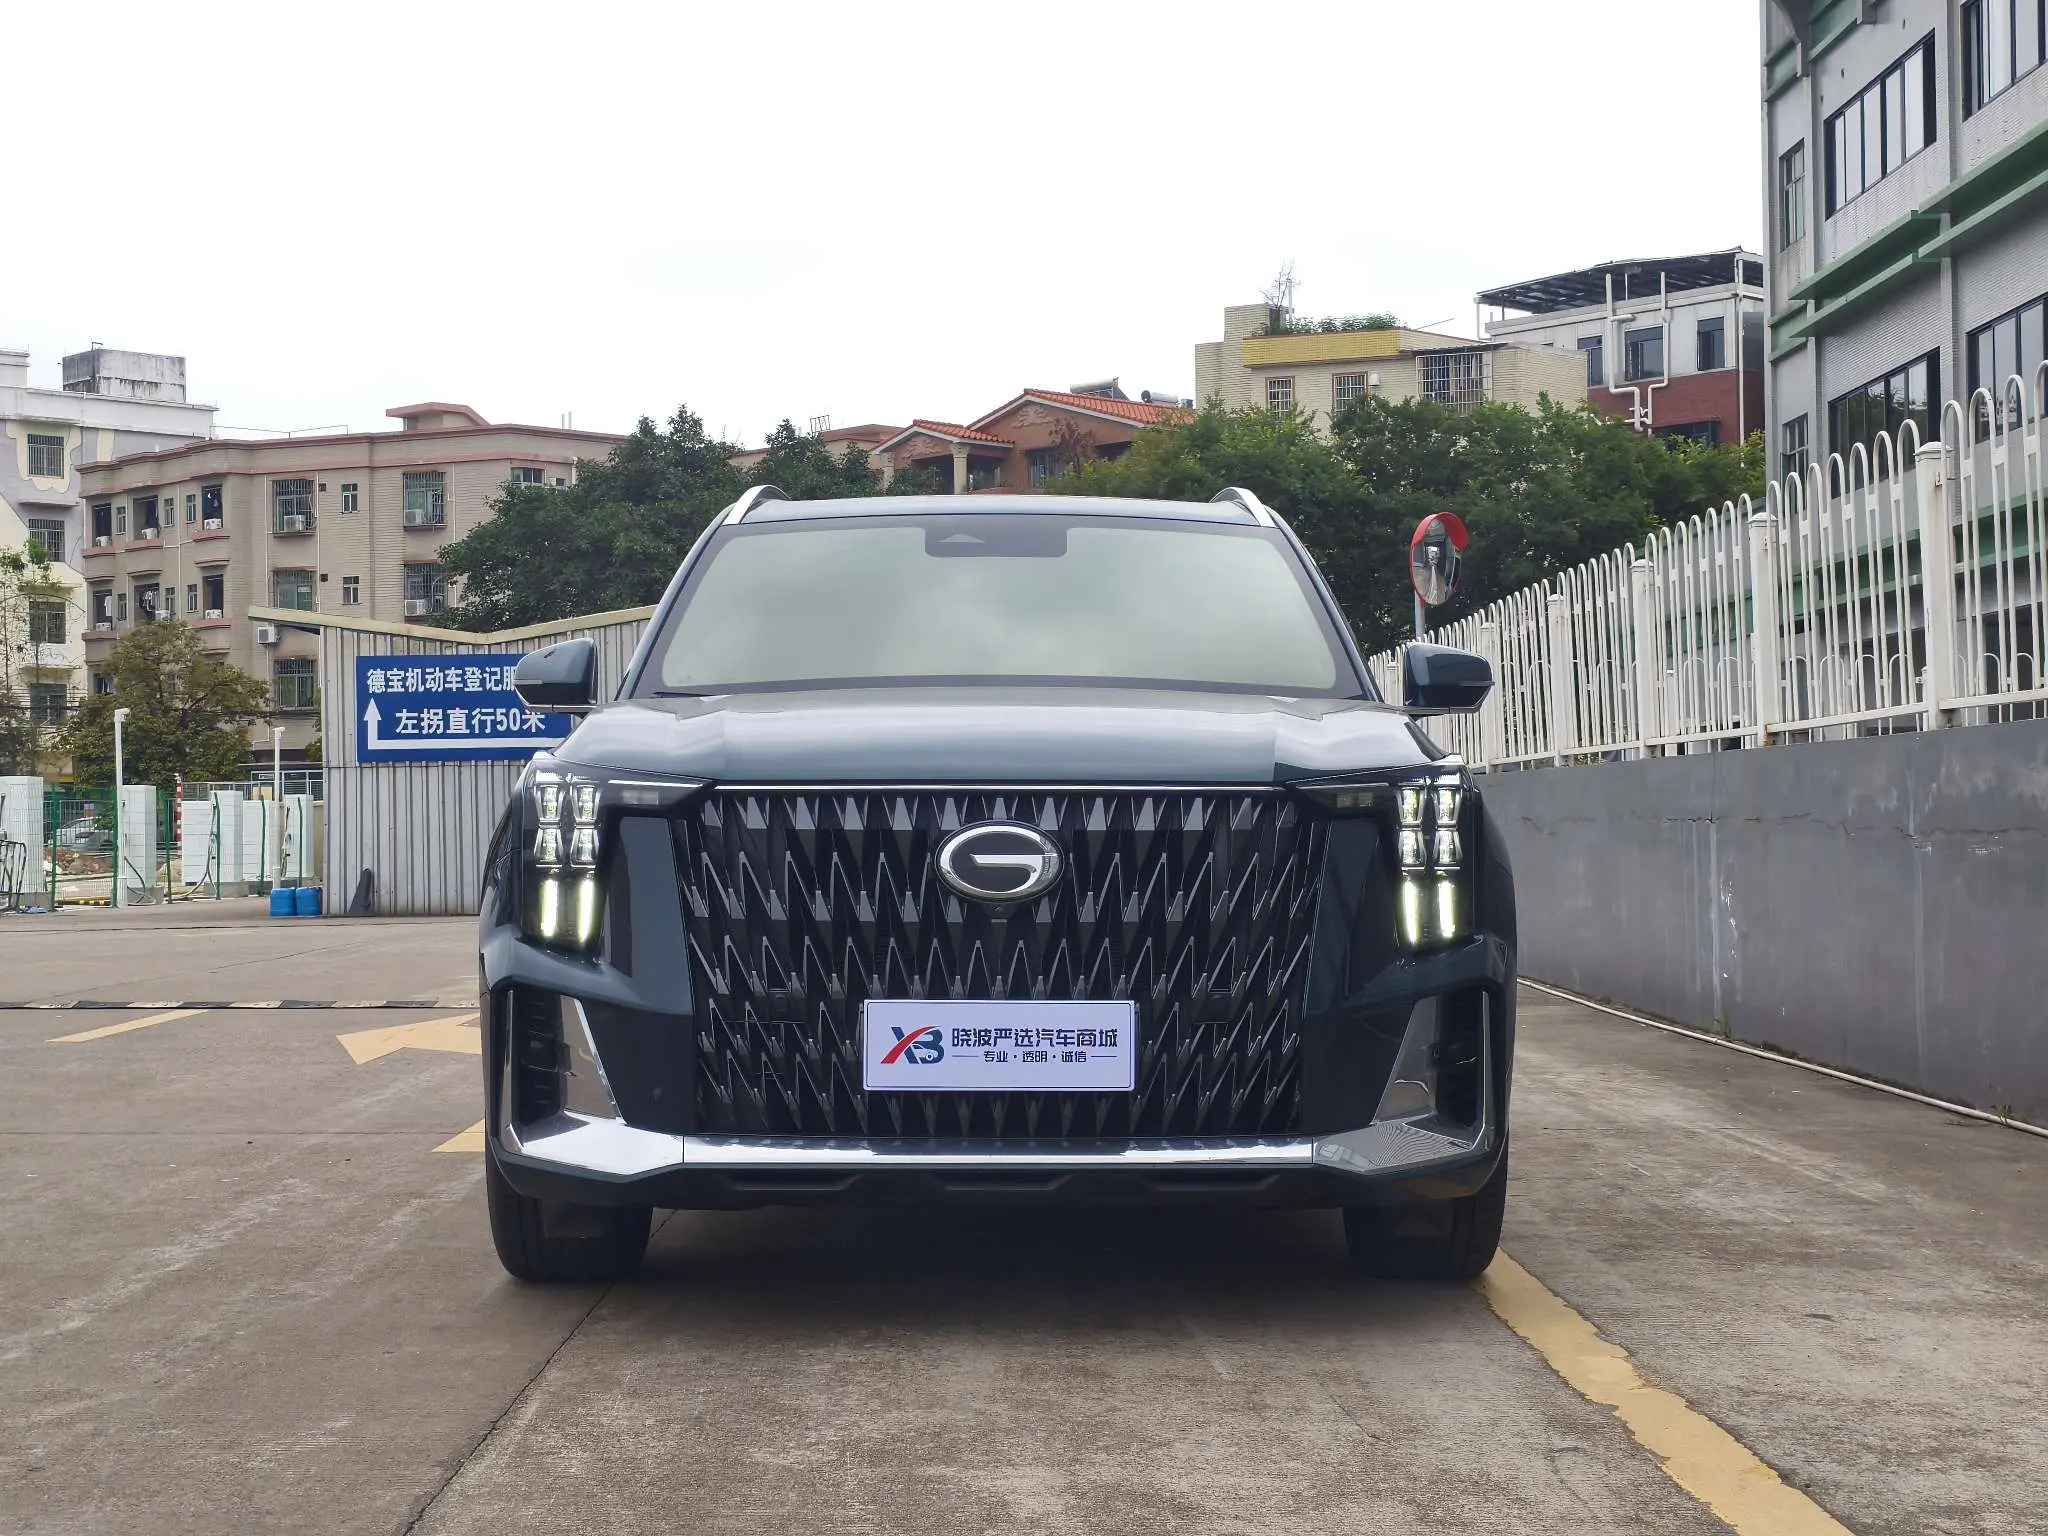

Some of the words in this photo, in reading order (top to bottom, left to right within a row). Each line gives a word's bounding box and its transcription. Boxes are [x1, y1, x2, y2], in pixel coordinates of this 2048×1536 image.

[396, 708, 545, 734] 左拐直行50米
[951, 1028, 1118, 1048] 晓波严选汽车商城
